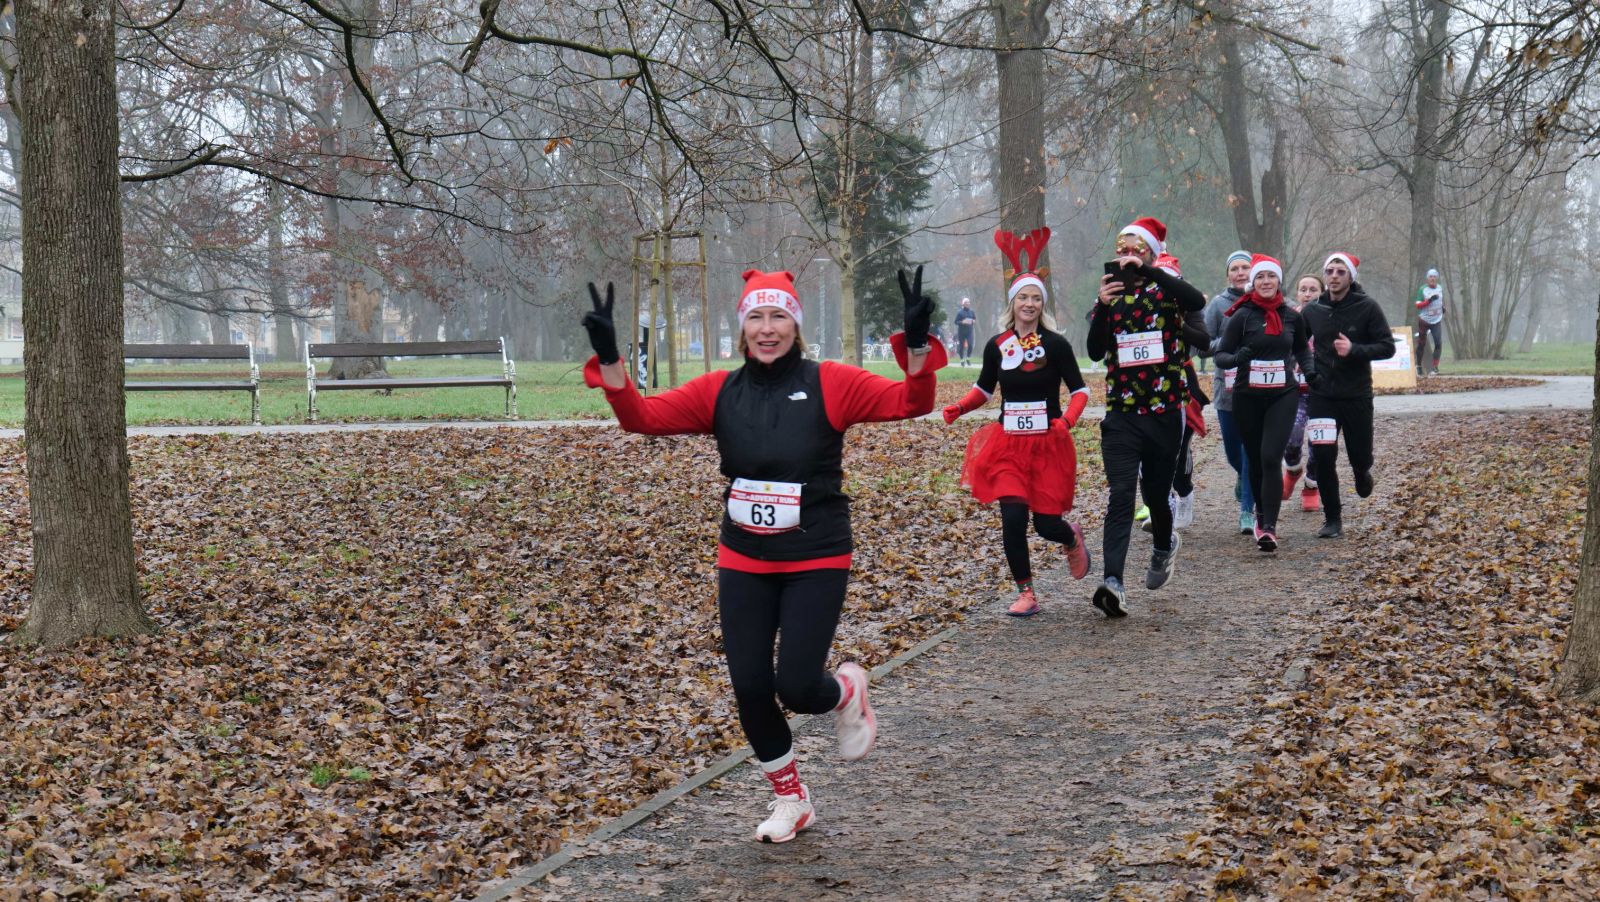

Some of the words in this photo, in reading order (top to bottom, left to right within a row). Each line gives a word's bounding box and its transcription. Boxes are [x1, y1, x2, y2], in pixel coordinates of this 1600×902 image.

[756, 291, 780, 304] Ho!
[1133, 346, 1149, 360] 66
[1263, 372, 1275, 383] 17
[1017, 416, 1033, 430] 65
[1313, 429, 1324, 440] 31
[751, 494, 778, 503] ADVENT
[751, 503, 776, 526] 63
